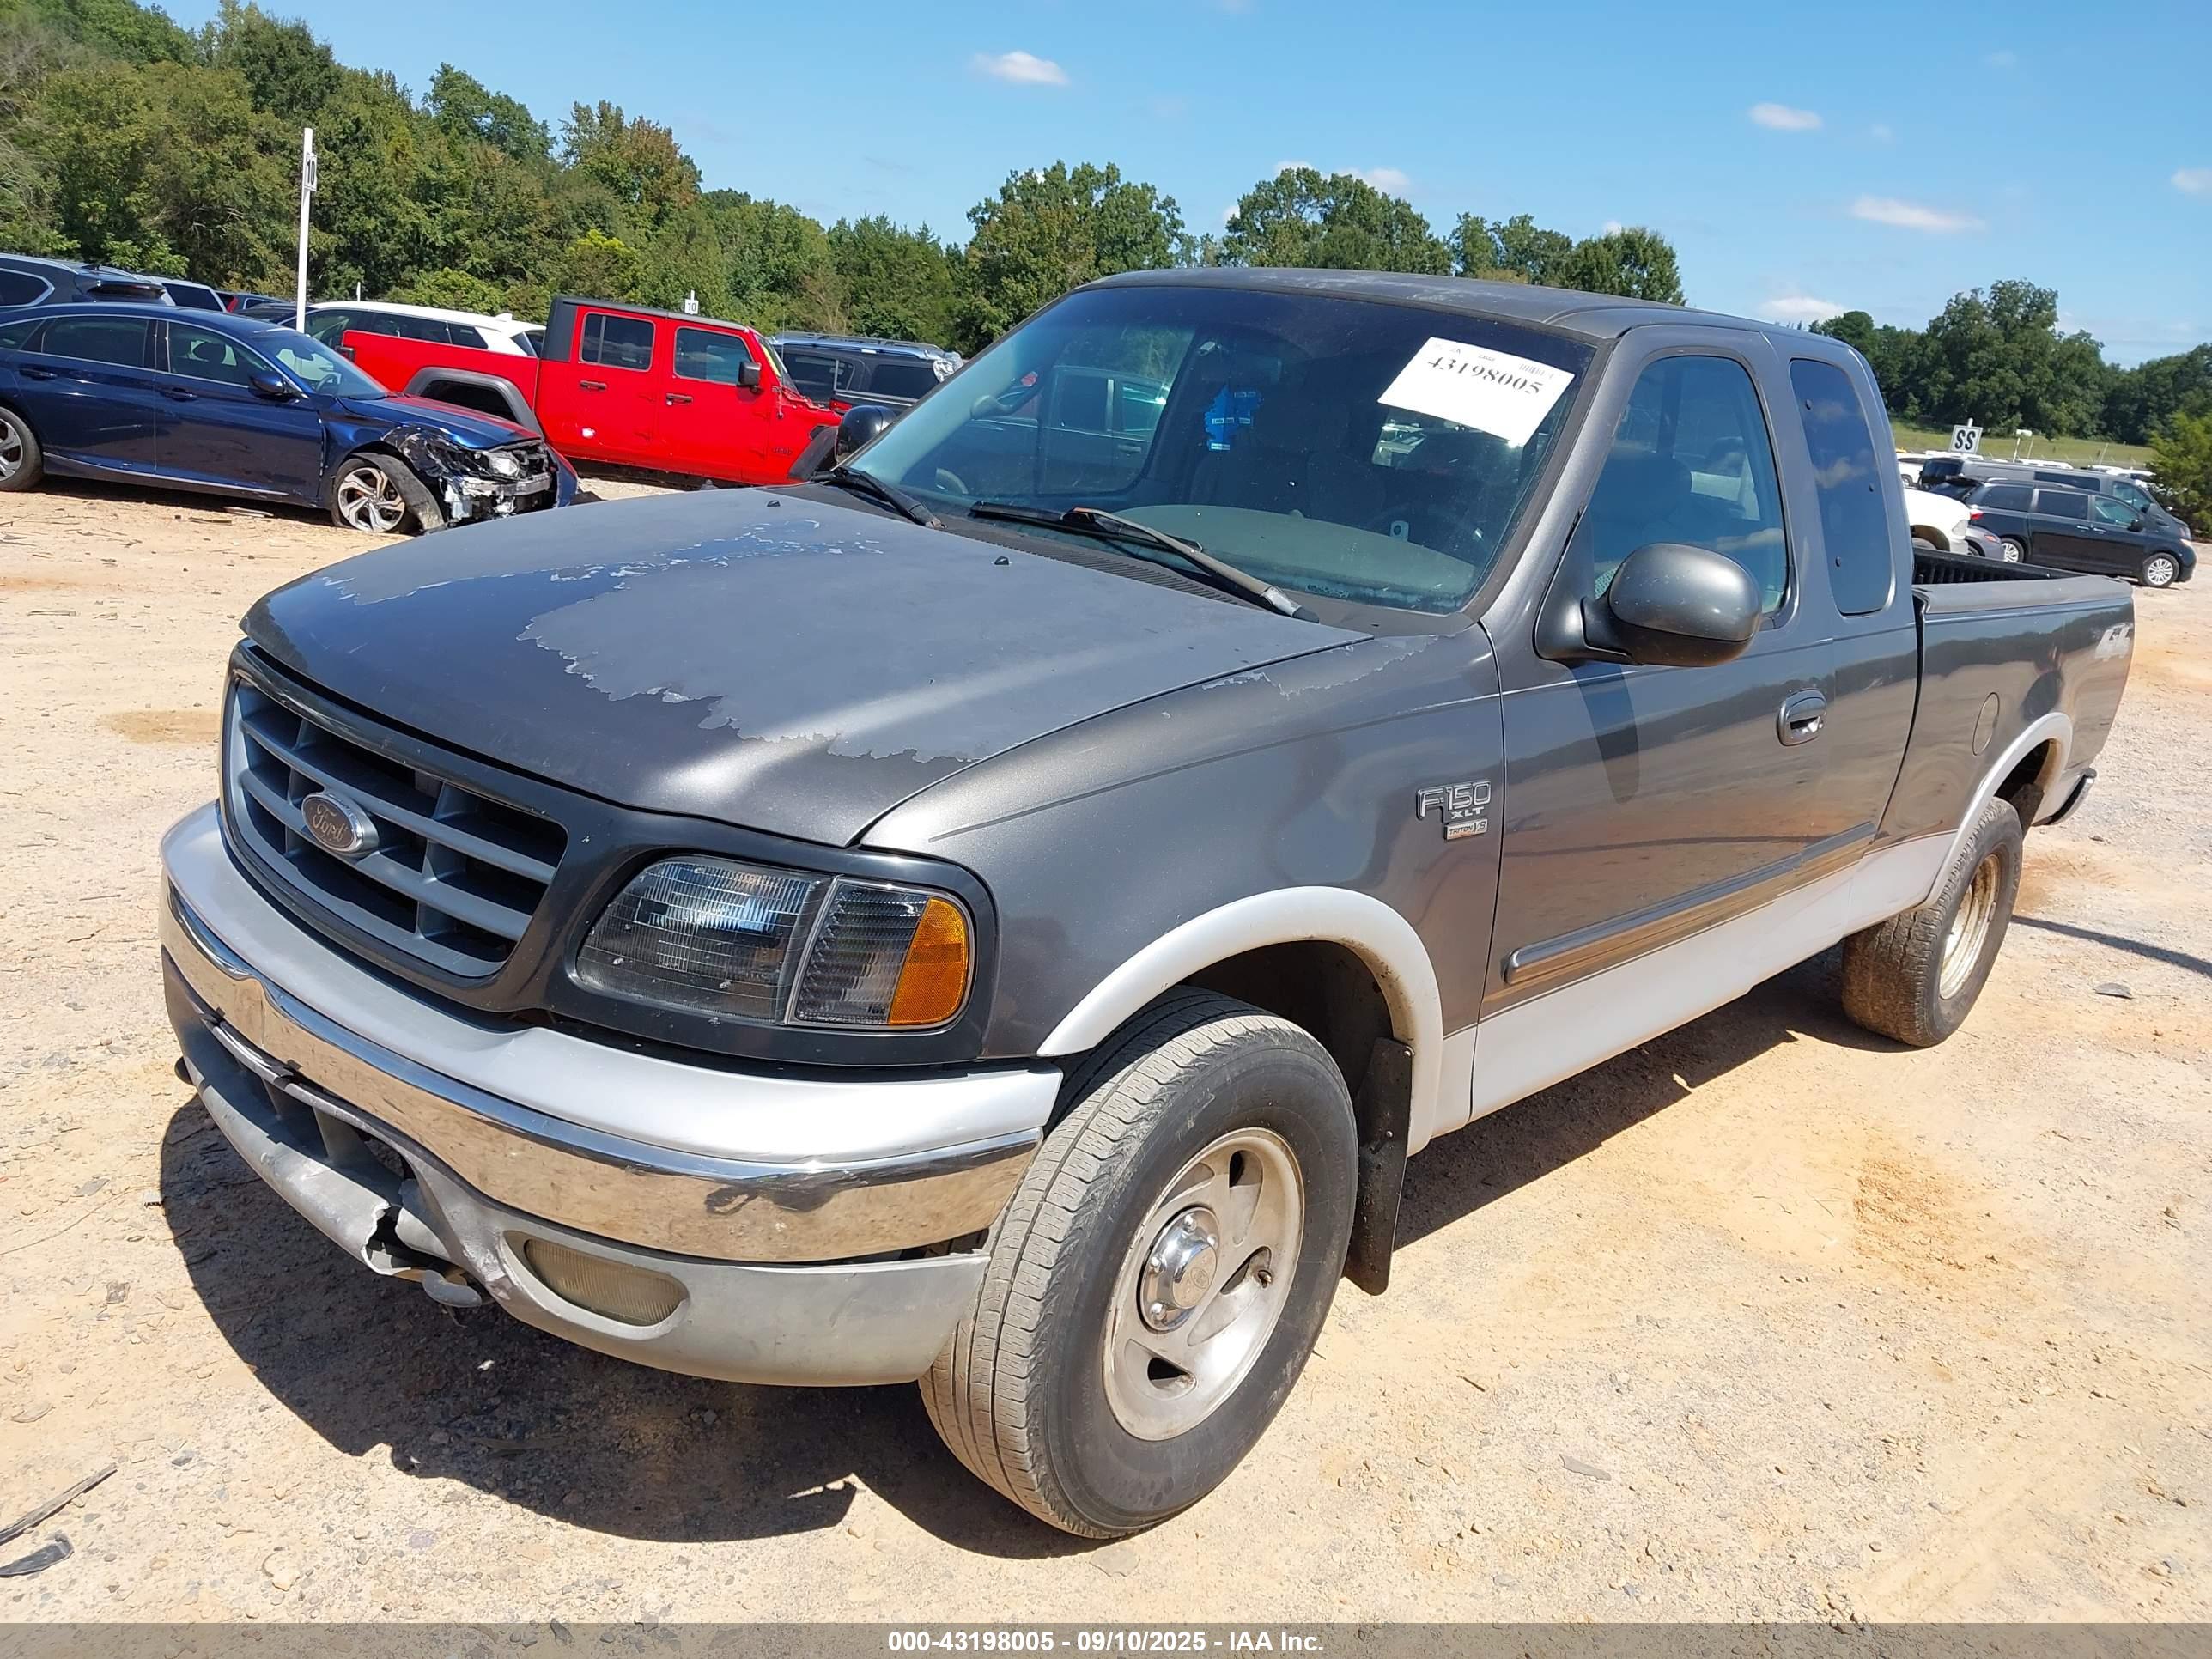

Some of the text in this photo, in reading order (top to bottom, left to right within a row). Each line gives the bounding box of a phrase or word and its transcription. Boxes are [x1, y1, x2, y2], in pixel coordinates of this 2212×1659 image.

[307, 158, 316, 185] 10
[688, 302, 696, 312] 10
[1427, 356, 1544, 395] 43198005
[1954, 429, 1976, 450] SS
[313, 804, 348, 842] Ford
[1451, 806, 1485, 819] XLT
[1449, 821, 1486, 835] TRITON V8
